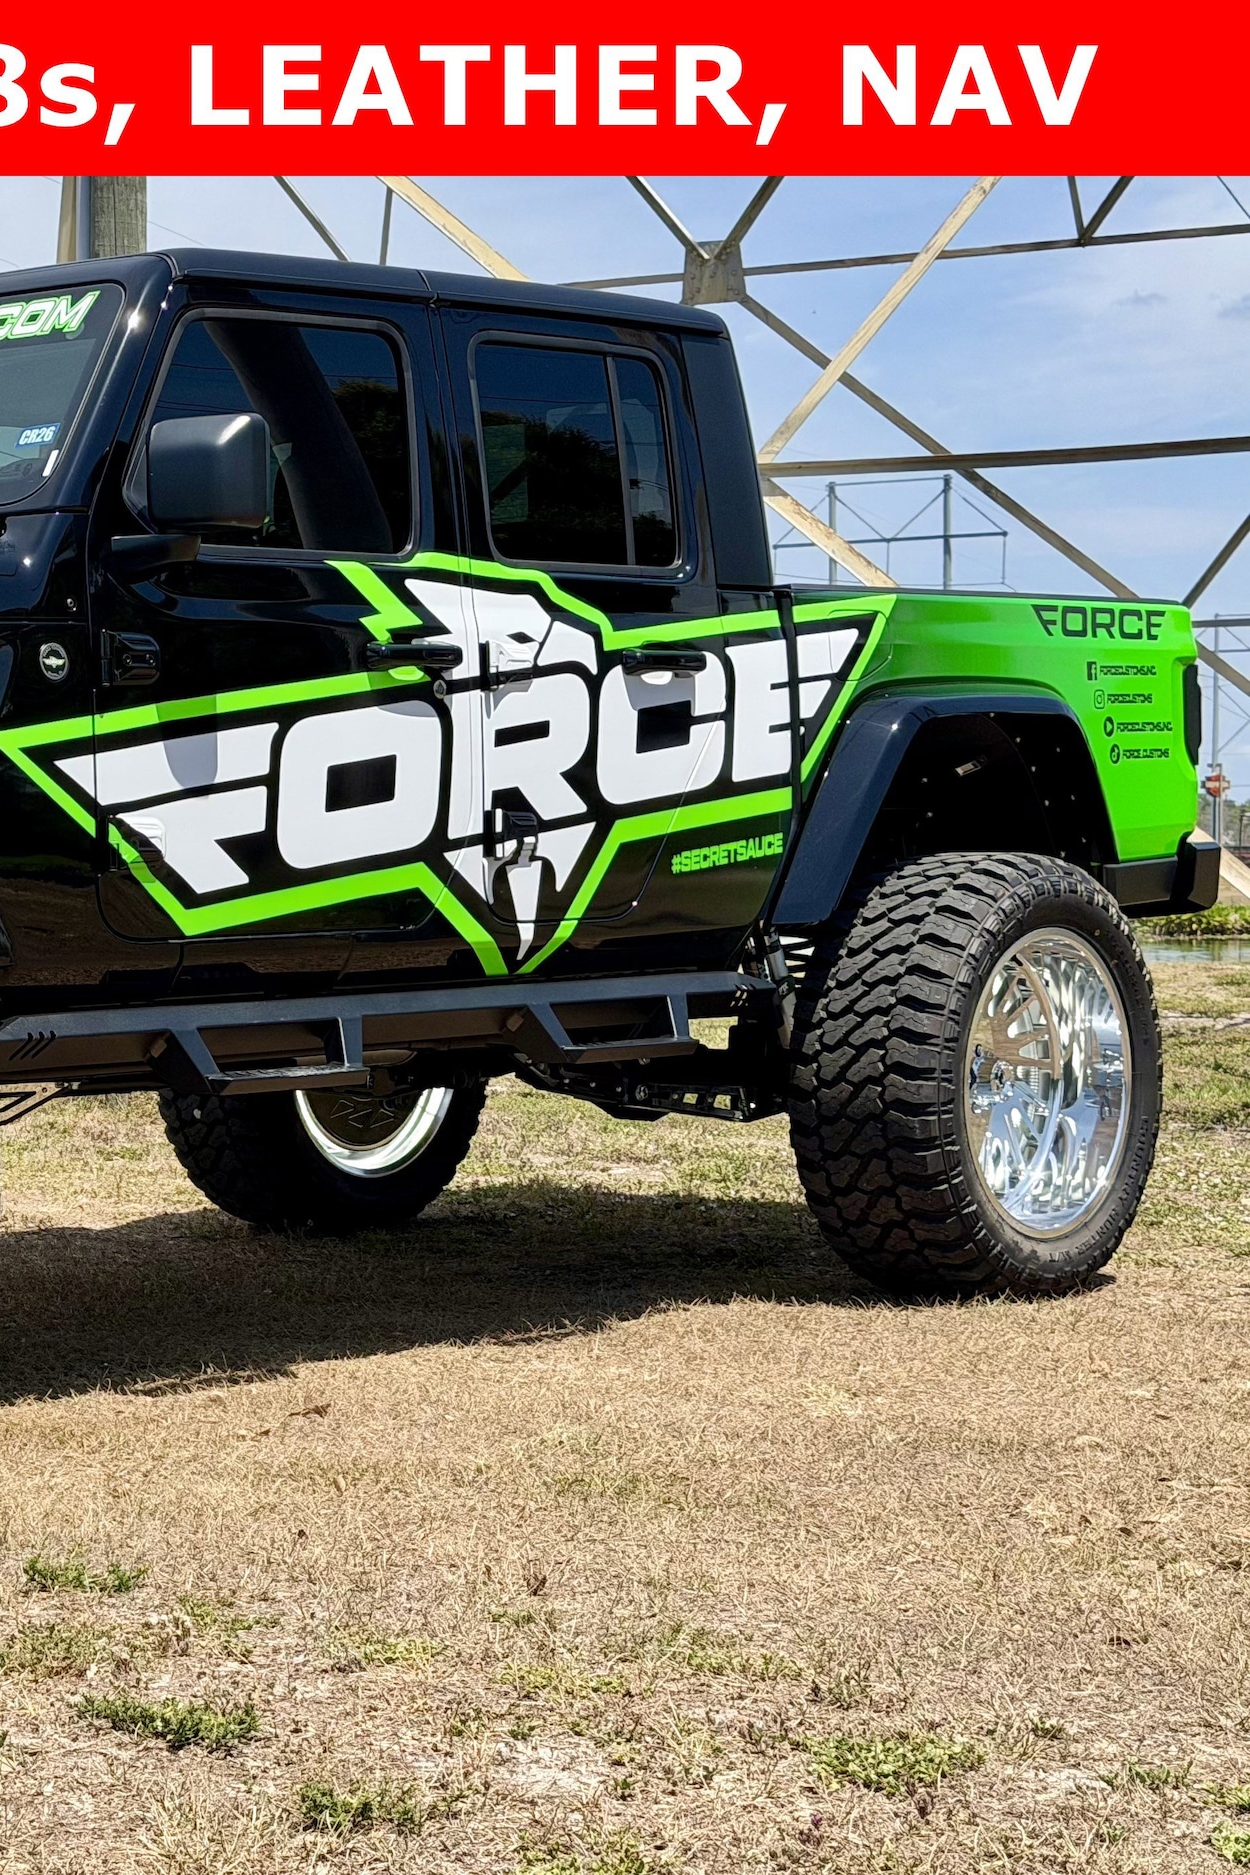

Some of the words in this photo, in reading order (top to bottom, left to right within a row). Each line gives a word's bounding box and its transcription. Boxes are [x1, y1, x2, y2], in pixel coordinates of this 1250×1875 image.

[18, 425, 56, 445] CR26
[1031, 604, 1166, 641] FORCE
[53, 627, 860, 894] FORCE
[671, 831, 784, 875] #SECRETSAUCE
